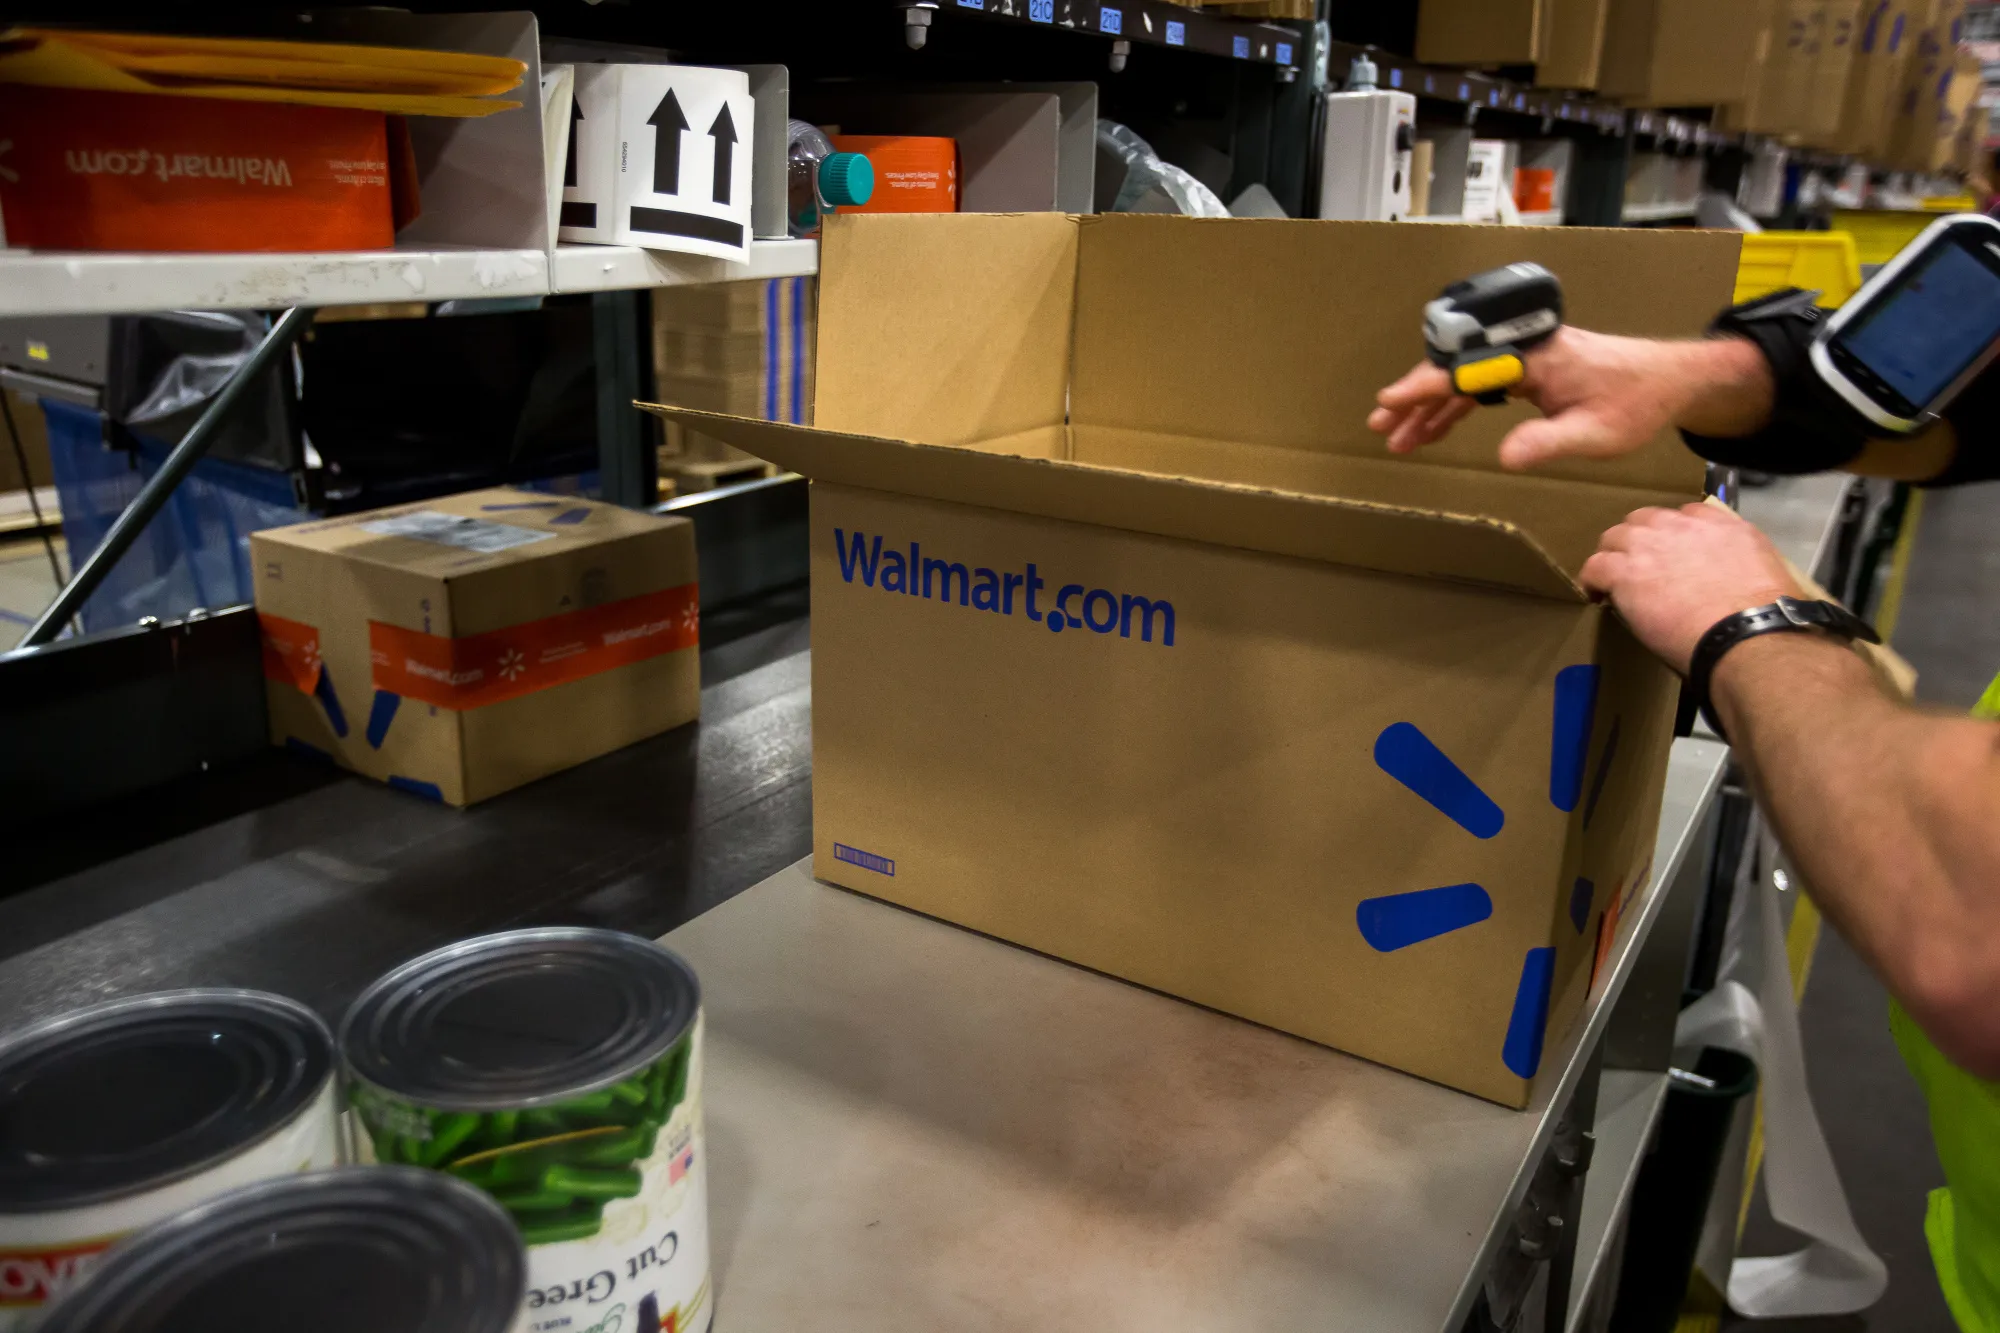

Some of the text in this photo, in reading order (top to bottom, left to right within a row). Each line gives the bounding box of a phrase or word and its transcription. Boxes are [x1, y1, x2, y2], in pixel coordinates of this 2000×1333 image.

[66, 149, 292, 187] Walmart.com
[834, 527, 1176, 647] Walmart.com
[526, 1231, 679, 1309] Cut Gree
